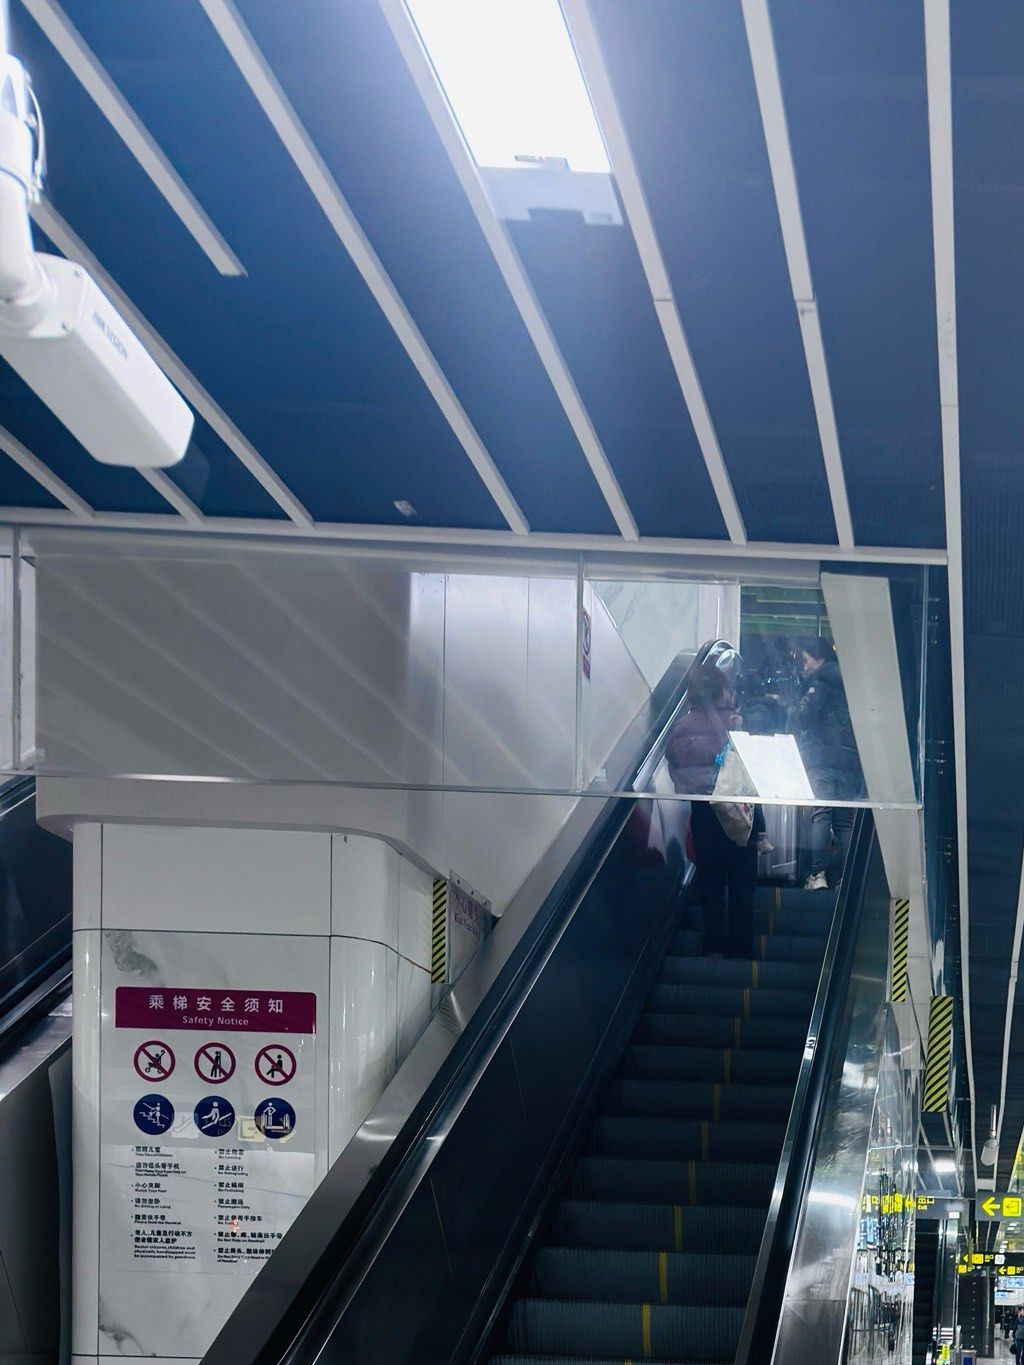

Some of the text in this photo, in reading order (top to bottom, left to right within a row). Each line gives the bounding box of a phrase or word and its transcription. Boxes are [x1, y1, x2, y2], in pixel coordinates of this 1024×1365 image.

[148, 994, 284, 1014] 乘梯安全须知
[182, 1015, 249, 1027] Safety Notice
